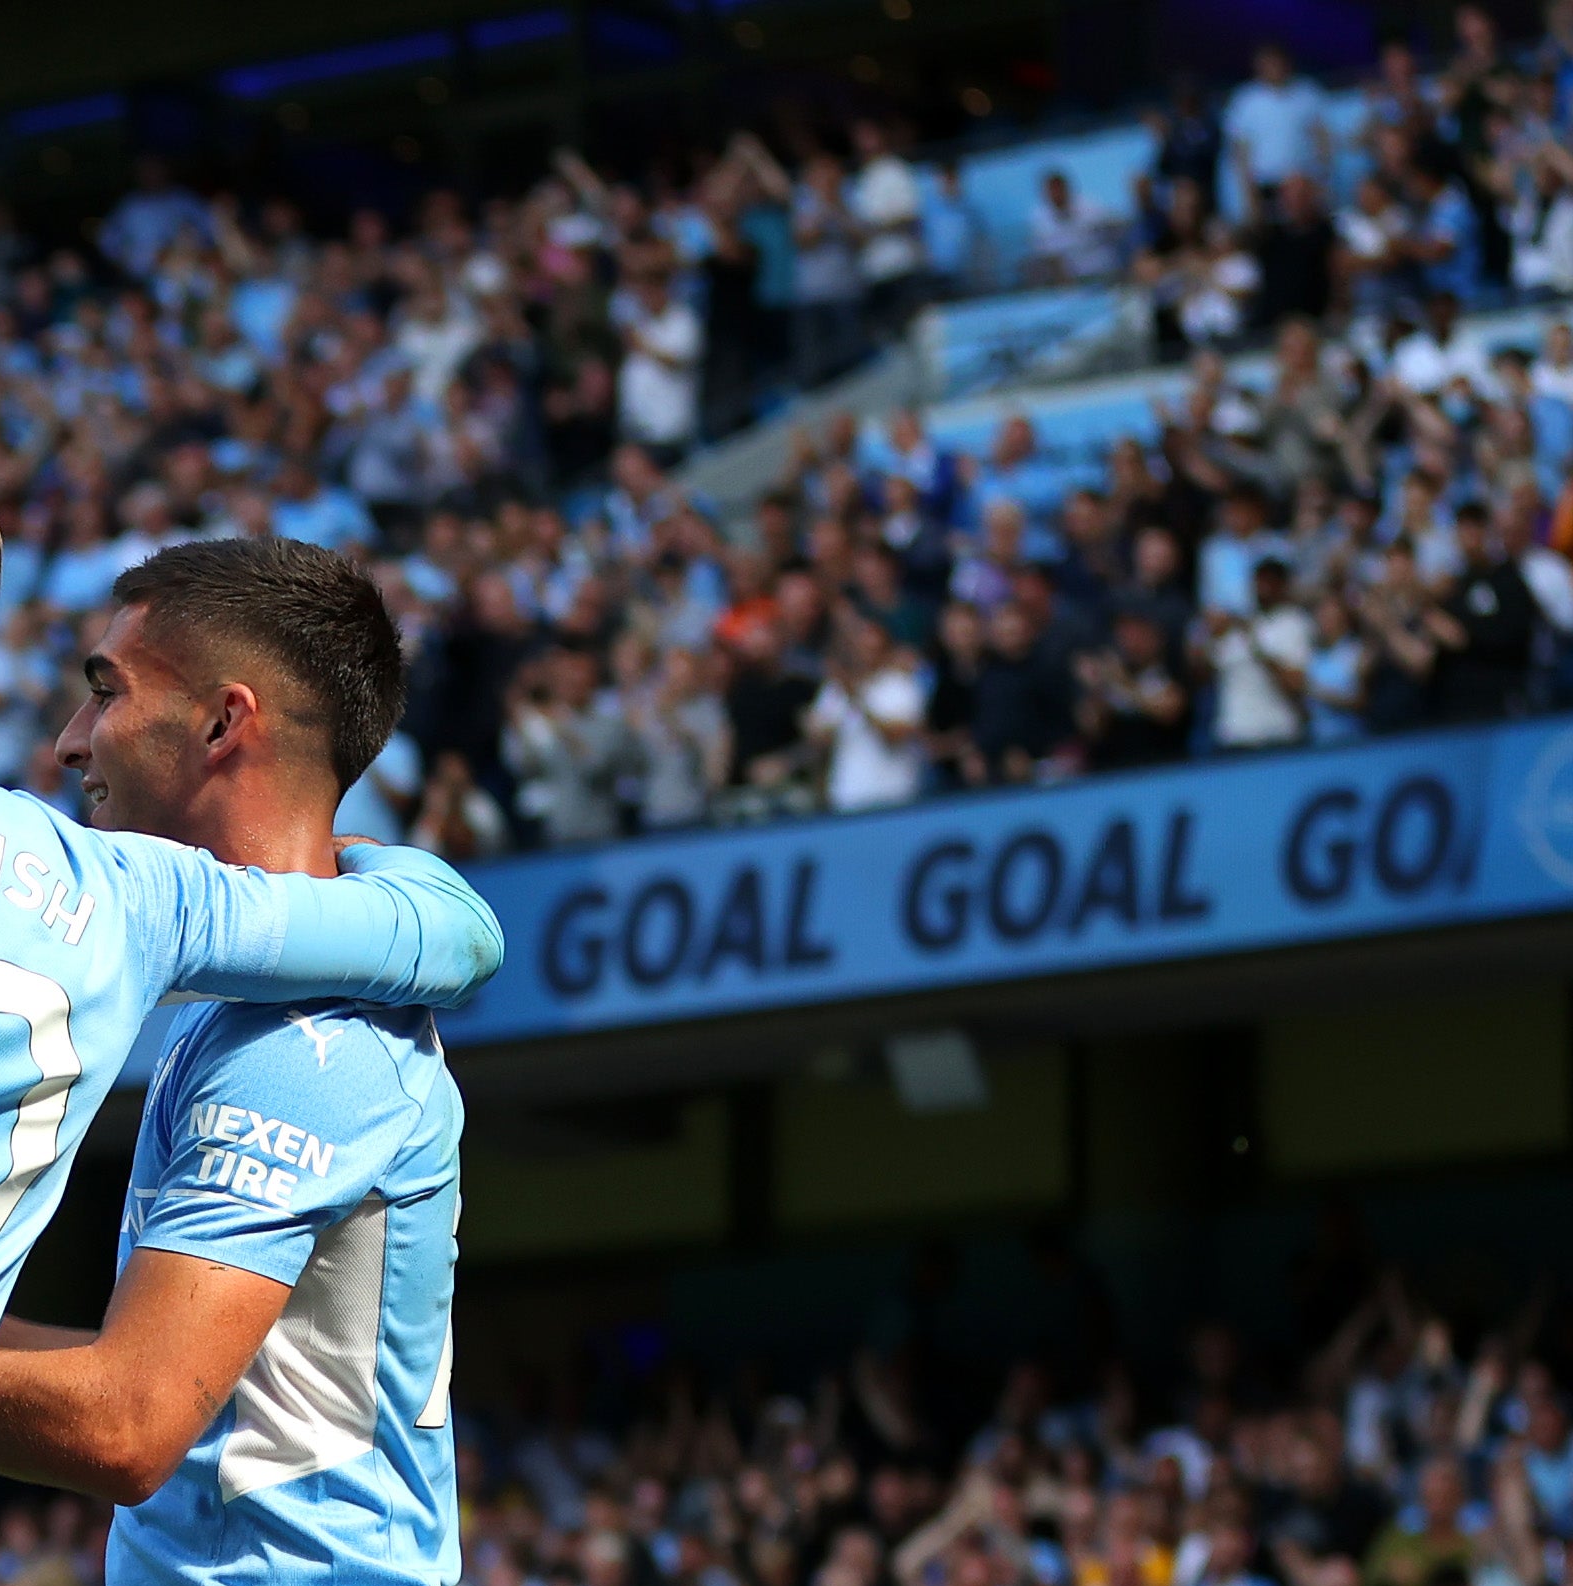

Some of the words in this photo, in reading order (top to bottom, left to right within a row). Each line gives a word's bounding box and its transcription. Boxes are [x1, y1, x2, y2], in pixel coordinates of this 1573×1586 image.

[537, 856, 837, 998] GOAL
[899, 807, 1212, 956] GOAL
[1283, 772, 1483, 907] GO
[187, 1101, 336, 1179] NEXEN
[196, 1144, 299, 1208] TIRE
